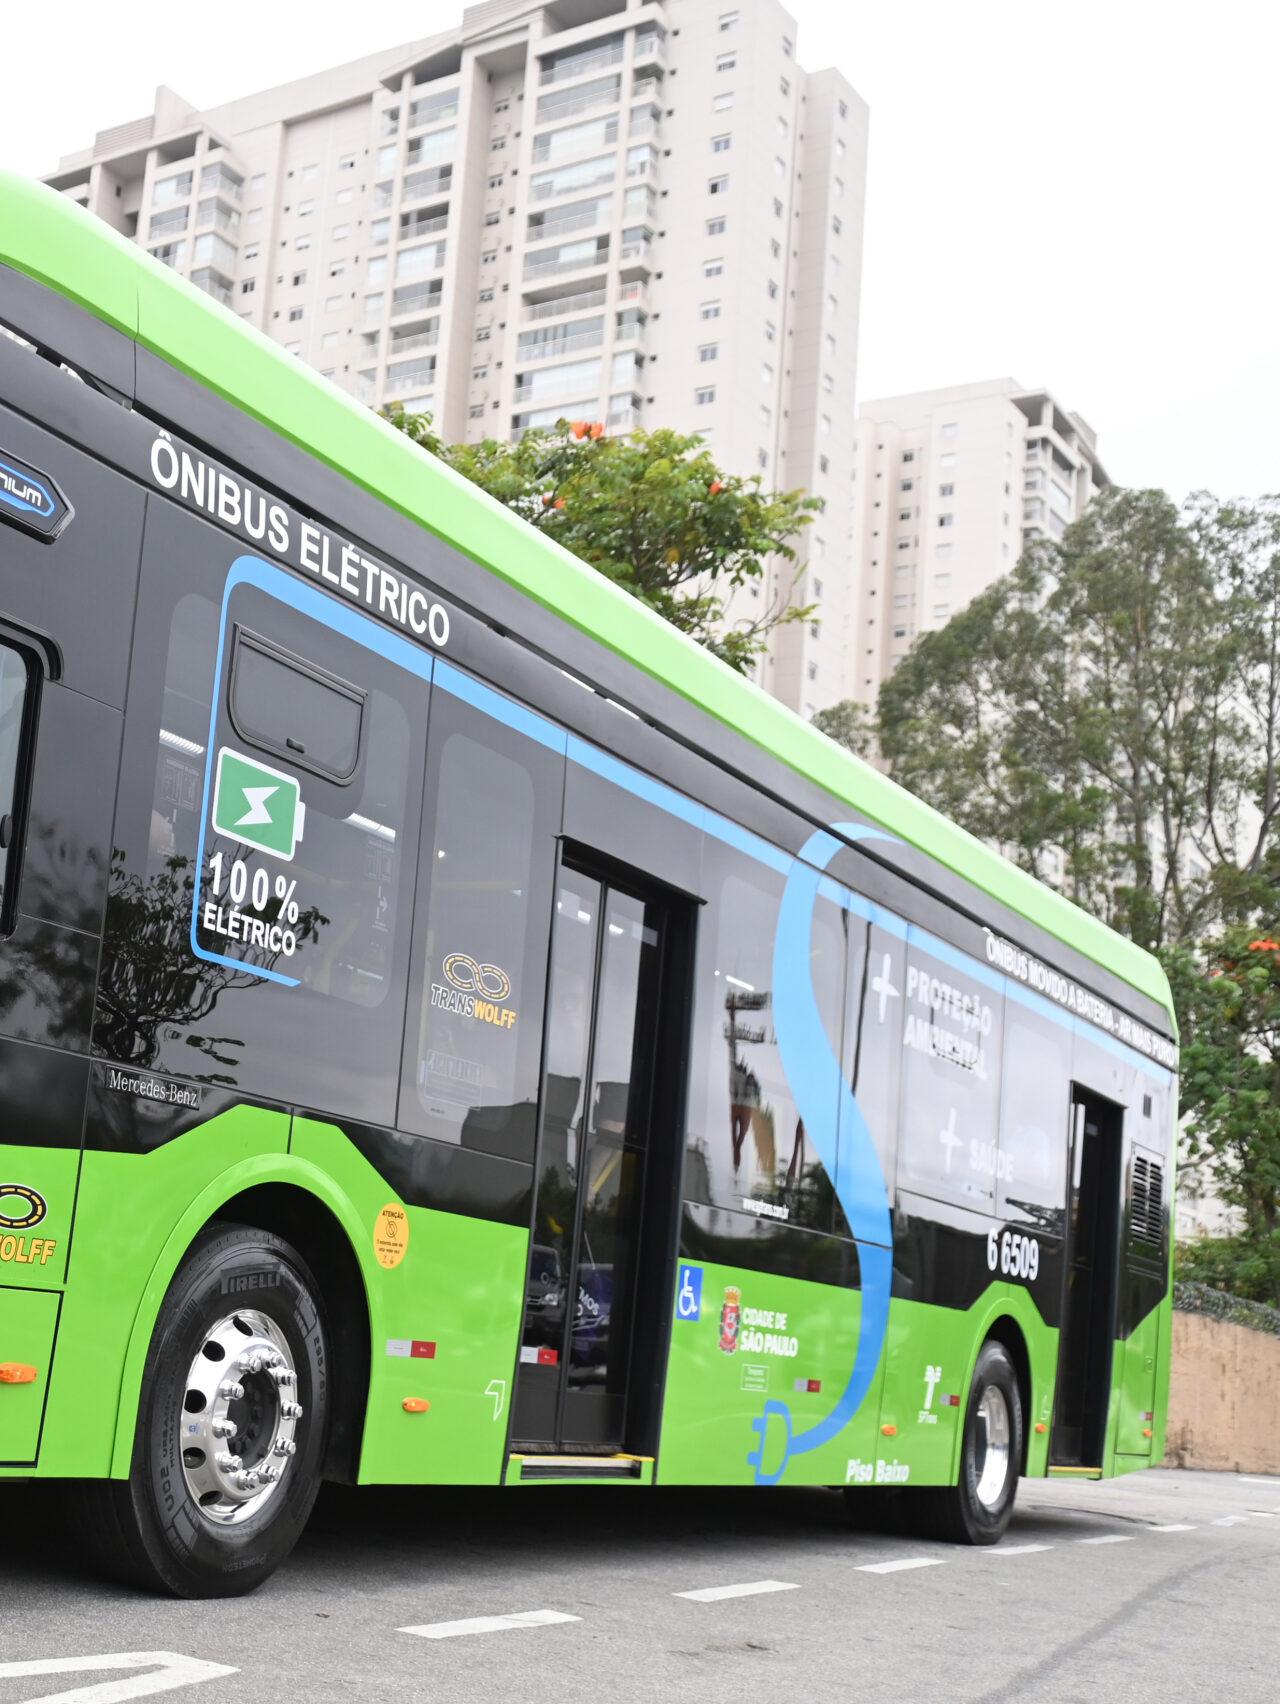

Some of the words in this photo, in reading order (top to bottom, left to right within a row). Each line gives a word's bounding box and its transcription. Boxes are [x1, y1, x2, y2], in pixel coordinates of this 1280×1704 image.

[150, 429, 290, 552] ÔNIBUS
[300, 521, 451, 646] ELÉTRICO
[209, 851, 299, 924] 100%
[203, 901, 296, 956] ELÉTRICO
[431, 983, 516, 1029] TRANSWOLFF
[906, 965, 992, 1036] PROTEÇÃO
[982, 926, 1028, 980] ÔNIBUS
[1028, 959, 1068, 1003] MOVIDO
[1076, 989, 1114, 1031] BATERIA
[1132, 1021, 1151, 1053] MAIS
[1152, 1035, 1175, 1067] PURO
[109, 1070, 197, 1106] Mercedes-Benz
[970, 1138, 1014, 1183] SAÚDE
[382, 1210, 404, 1219] ATENÇÃO
[987, 1227, 998, 1271] 6
[1001, 1231, 1039, 1281] 6509
[220, 1262, 280, 1295] PIRELLI
[740, 1326, 764, 1353] SÃO
[764, 1333, 798, 1357] PAULO
[742, 1307, 775, 1328] CIDADE
[775, 1312, 788, 1331] DE
[845, 1458, 874, 1482] Piso
[875, 1459, 910, 1482] Baixo
